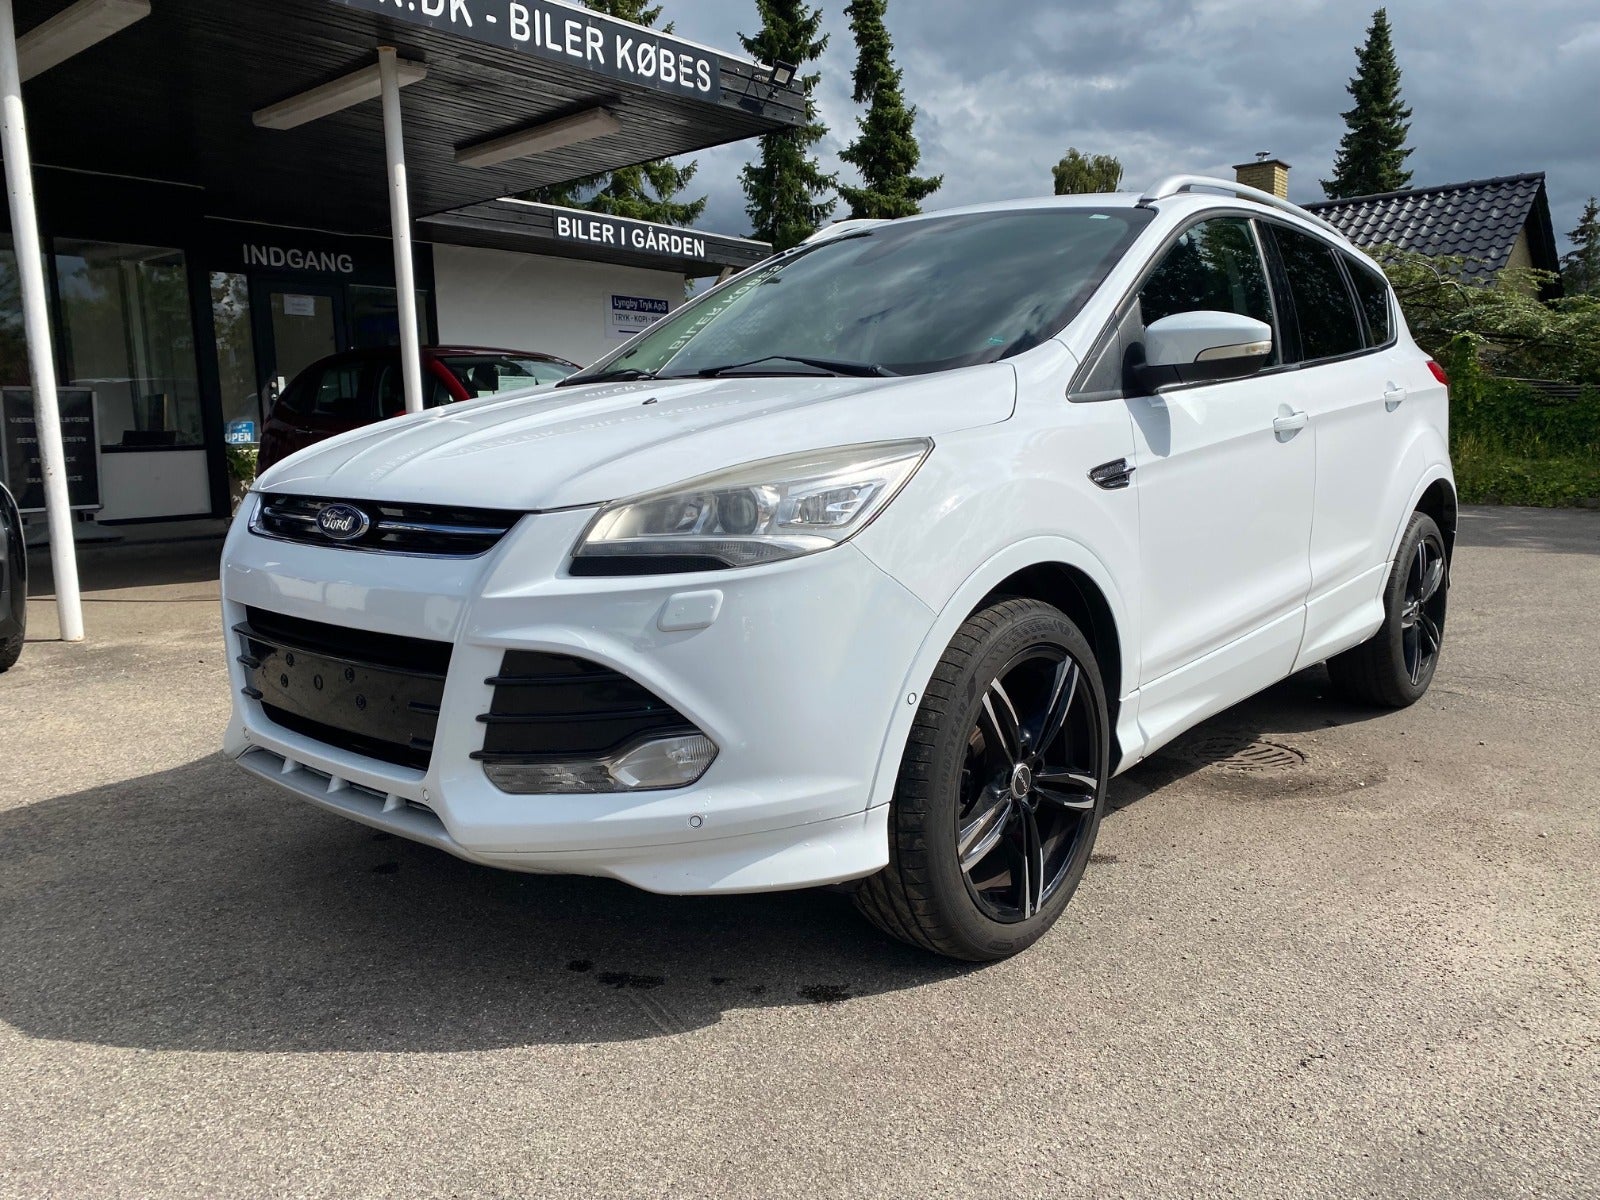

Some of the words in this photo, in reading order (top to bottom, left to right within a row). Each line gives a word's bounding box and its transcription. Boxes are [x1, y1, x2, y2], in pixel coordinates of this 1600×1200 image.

[509, 2, 605, 65] BILER
[615, 34, 712, 92] KØBES
[557, 216, 614, 244] BILER
[620, 226, 626, 246] I
[631, 226, 705, 258] GÅRDEN
[242, 243, 354, 273] INDGANG
[614, 297, 638, 309] Lyngby
[639, 299, 653, 311] Tryk
[653, 301, 666, 311] ApS
[614, 313, 630, 321] TRYK
[224, 432, 252, 443] OPEN
[322, 508, 352, 531] Ford
